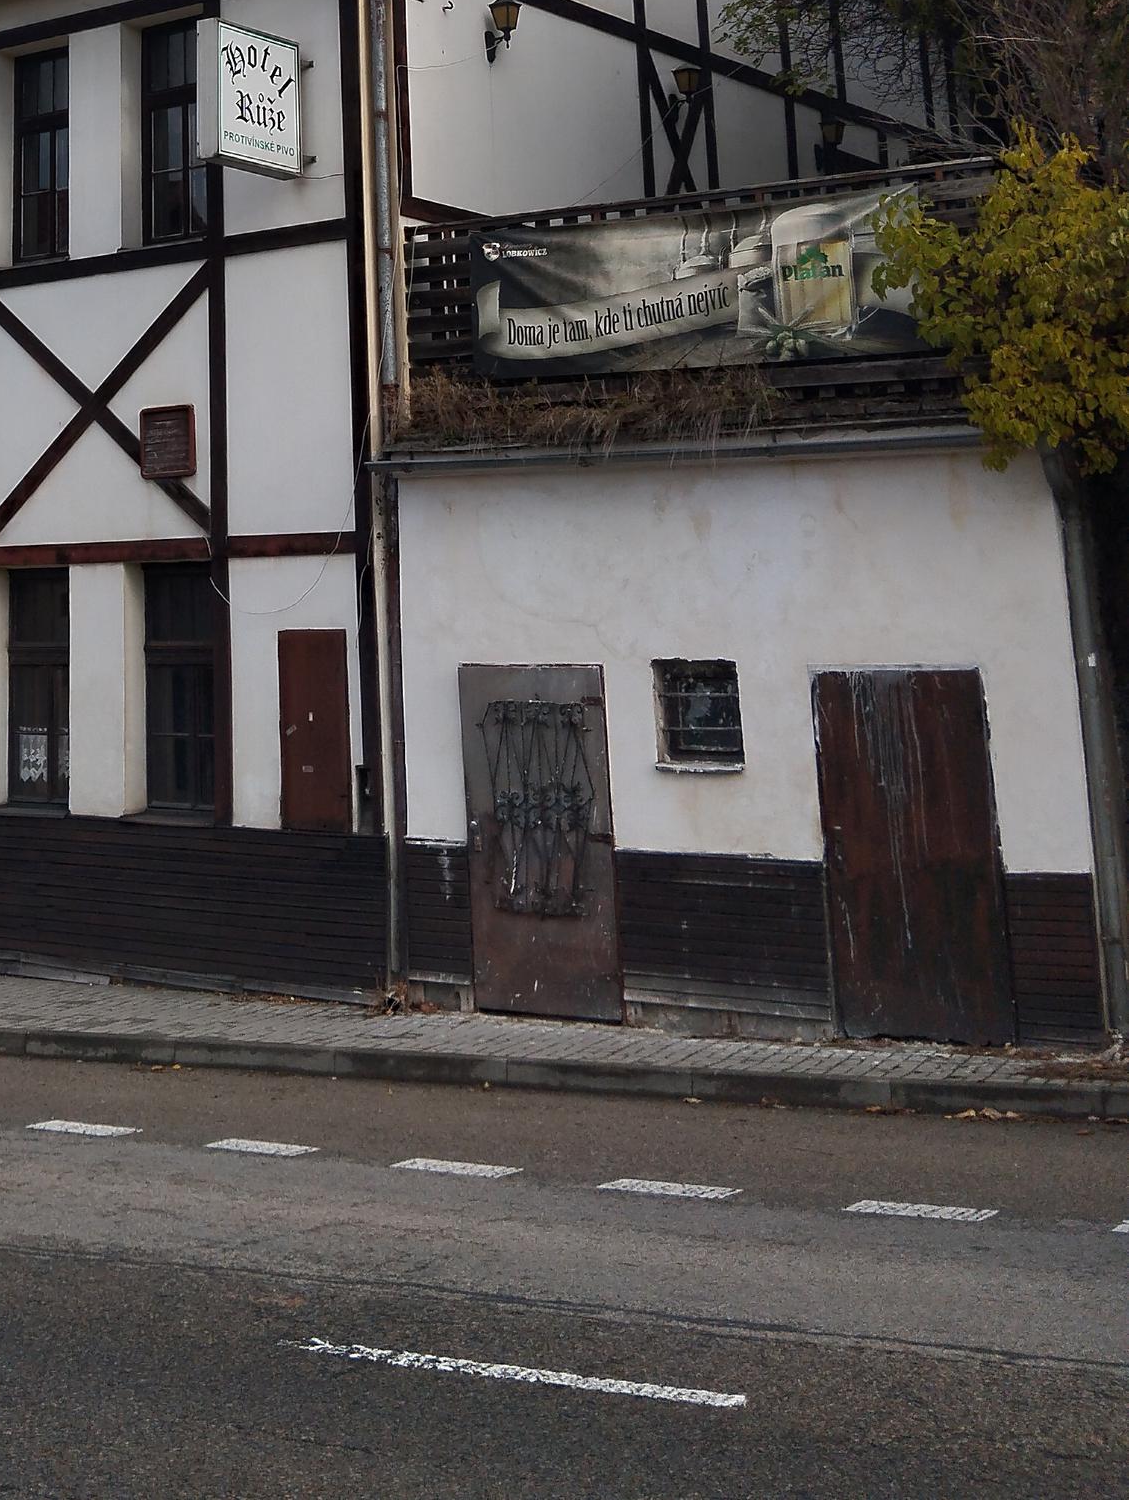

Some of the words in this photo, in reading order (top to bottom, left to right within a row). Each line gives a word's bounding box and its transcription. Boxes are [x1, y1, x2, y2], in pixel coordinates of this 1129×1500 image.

[221, 40, 295, 99] Hotel
[236, 90, 286, 135] Růže
[224, 130, 275, 152] PROTIVÍNSKÉ
[276, 144, 295, 156] PIVO
[502, 248, 548, 258] LOBKOWICZ
[780, 264, 845, 281] Platan
[507, 317, 545, 346] Doma
[546, 317, 560, 349] je
[562, 318, 594, 343] tam,
[594, 309, 620, 338] kde
[622, 302, 634, 331] ti
[636, 291, 684, 329] chutná
[687, 282, 731, 318] nejvíc
